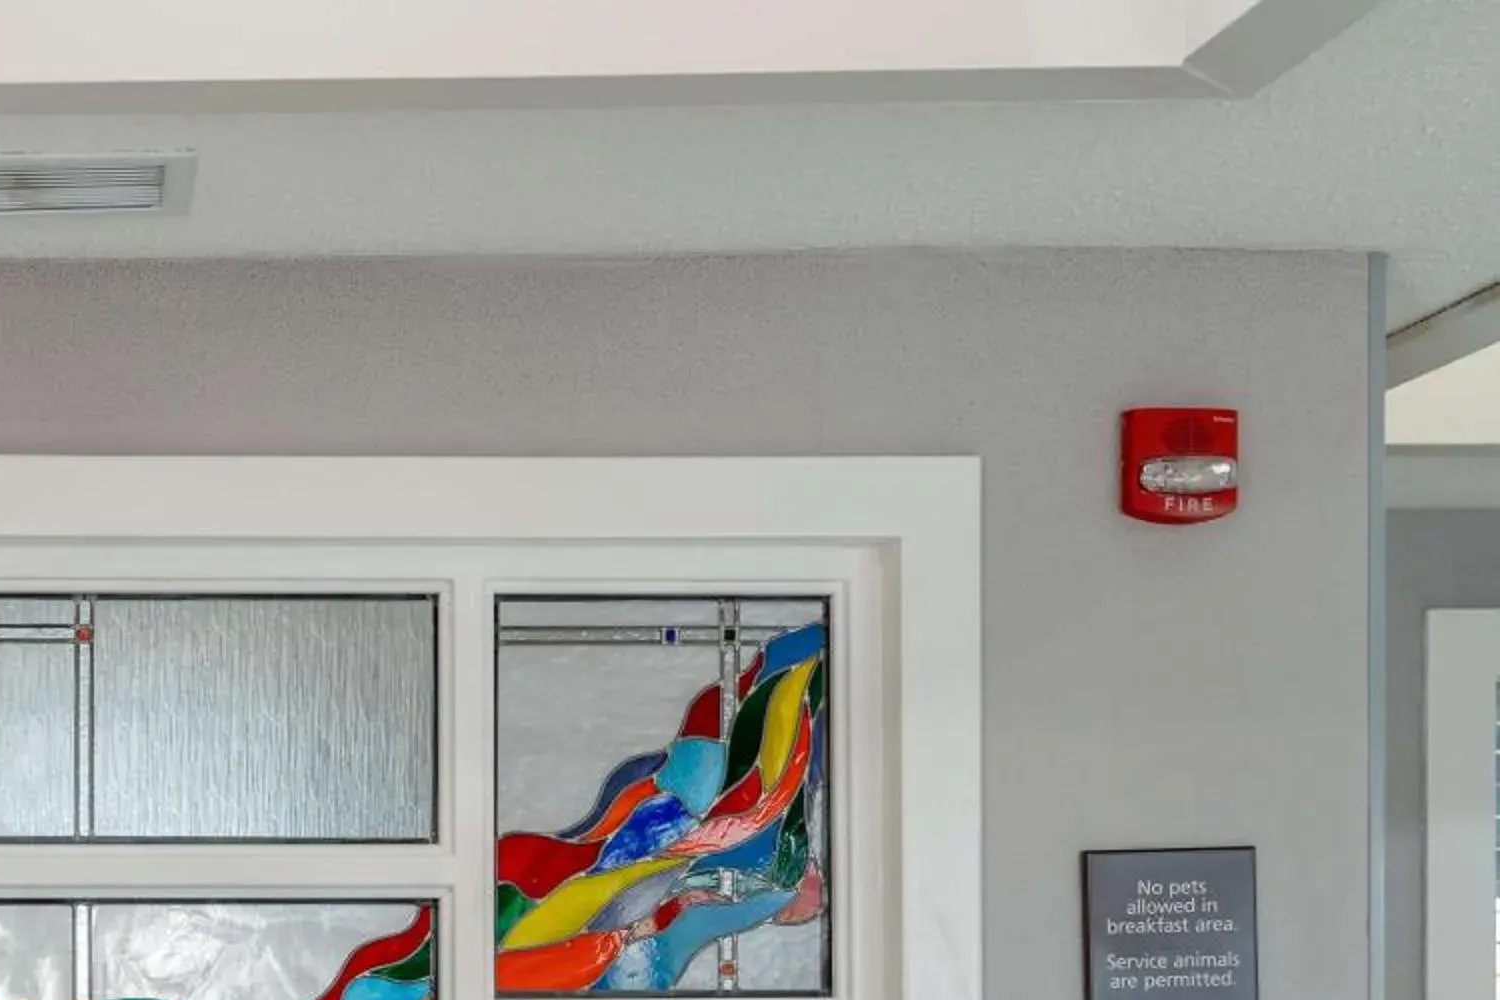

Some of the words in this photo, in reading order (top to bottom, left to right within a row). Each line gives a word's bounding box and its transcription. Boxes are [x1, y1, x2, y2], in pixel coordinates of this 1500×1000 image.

[1165, 496, 1213, 512] FIRE
[1137, 880, 1163, 895] No
[1169, 880, 1207, 898] pets
[1127, 898, 1196, 914] allowed
[1201, 898, 1218, 912] in
[1107, 918, 1189, 935] breakfast
[1196, 919, 1238, 933] area.
[1106, 953, 1168, 970] Service
[1173, 951, 1240, 969] animals
[1110, 975, 1138, 989] are
[1144, 970, 1237, 991] permitted.
